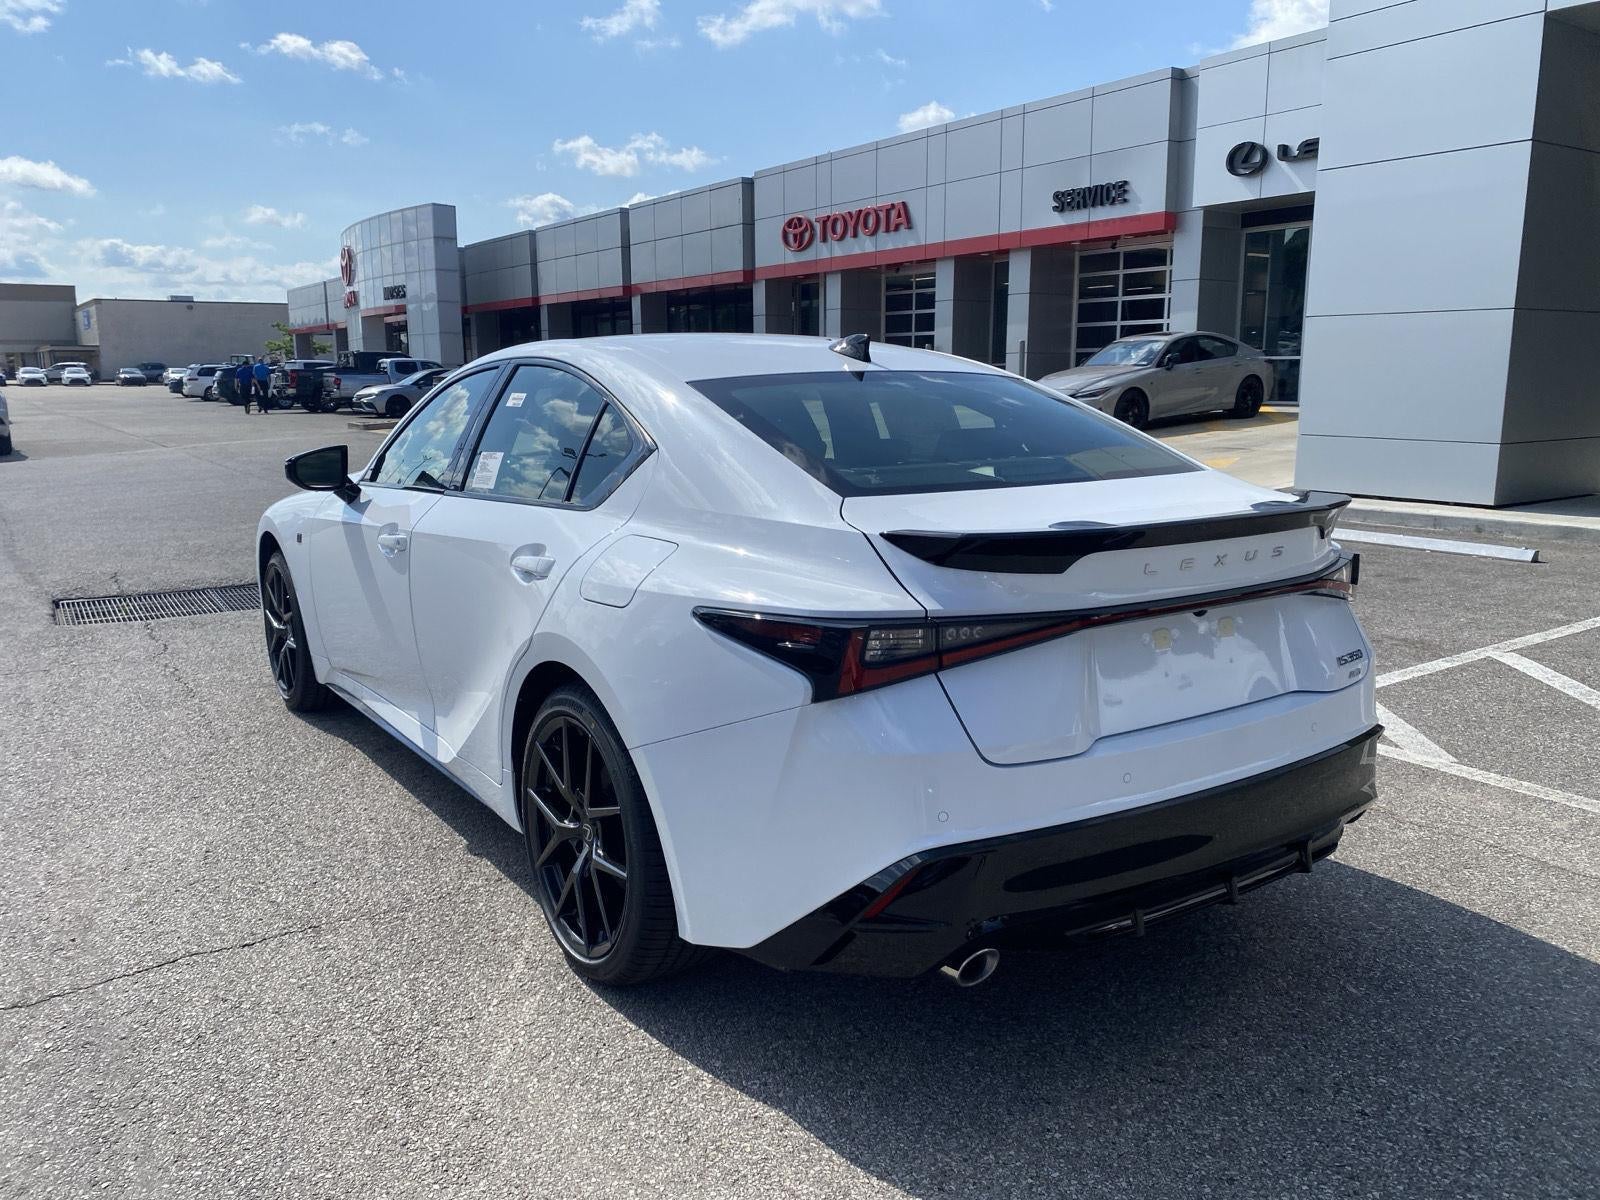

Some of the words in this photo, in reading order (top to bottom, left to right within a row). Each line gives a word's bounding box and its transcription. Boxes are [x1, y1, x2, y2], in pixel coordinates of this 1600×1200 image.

[1052, 180, 1129, 212] SERVICE
[815, 201, 912, 242] TOYOTA
[1143, 546, 1285, 575] LEXUS
